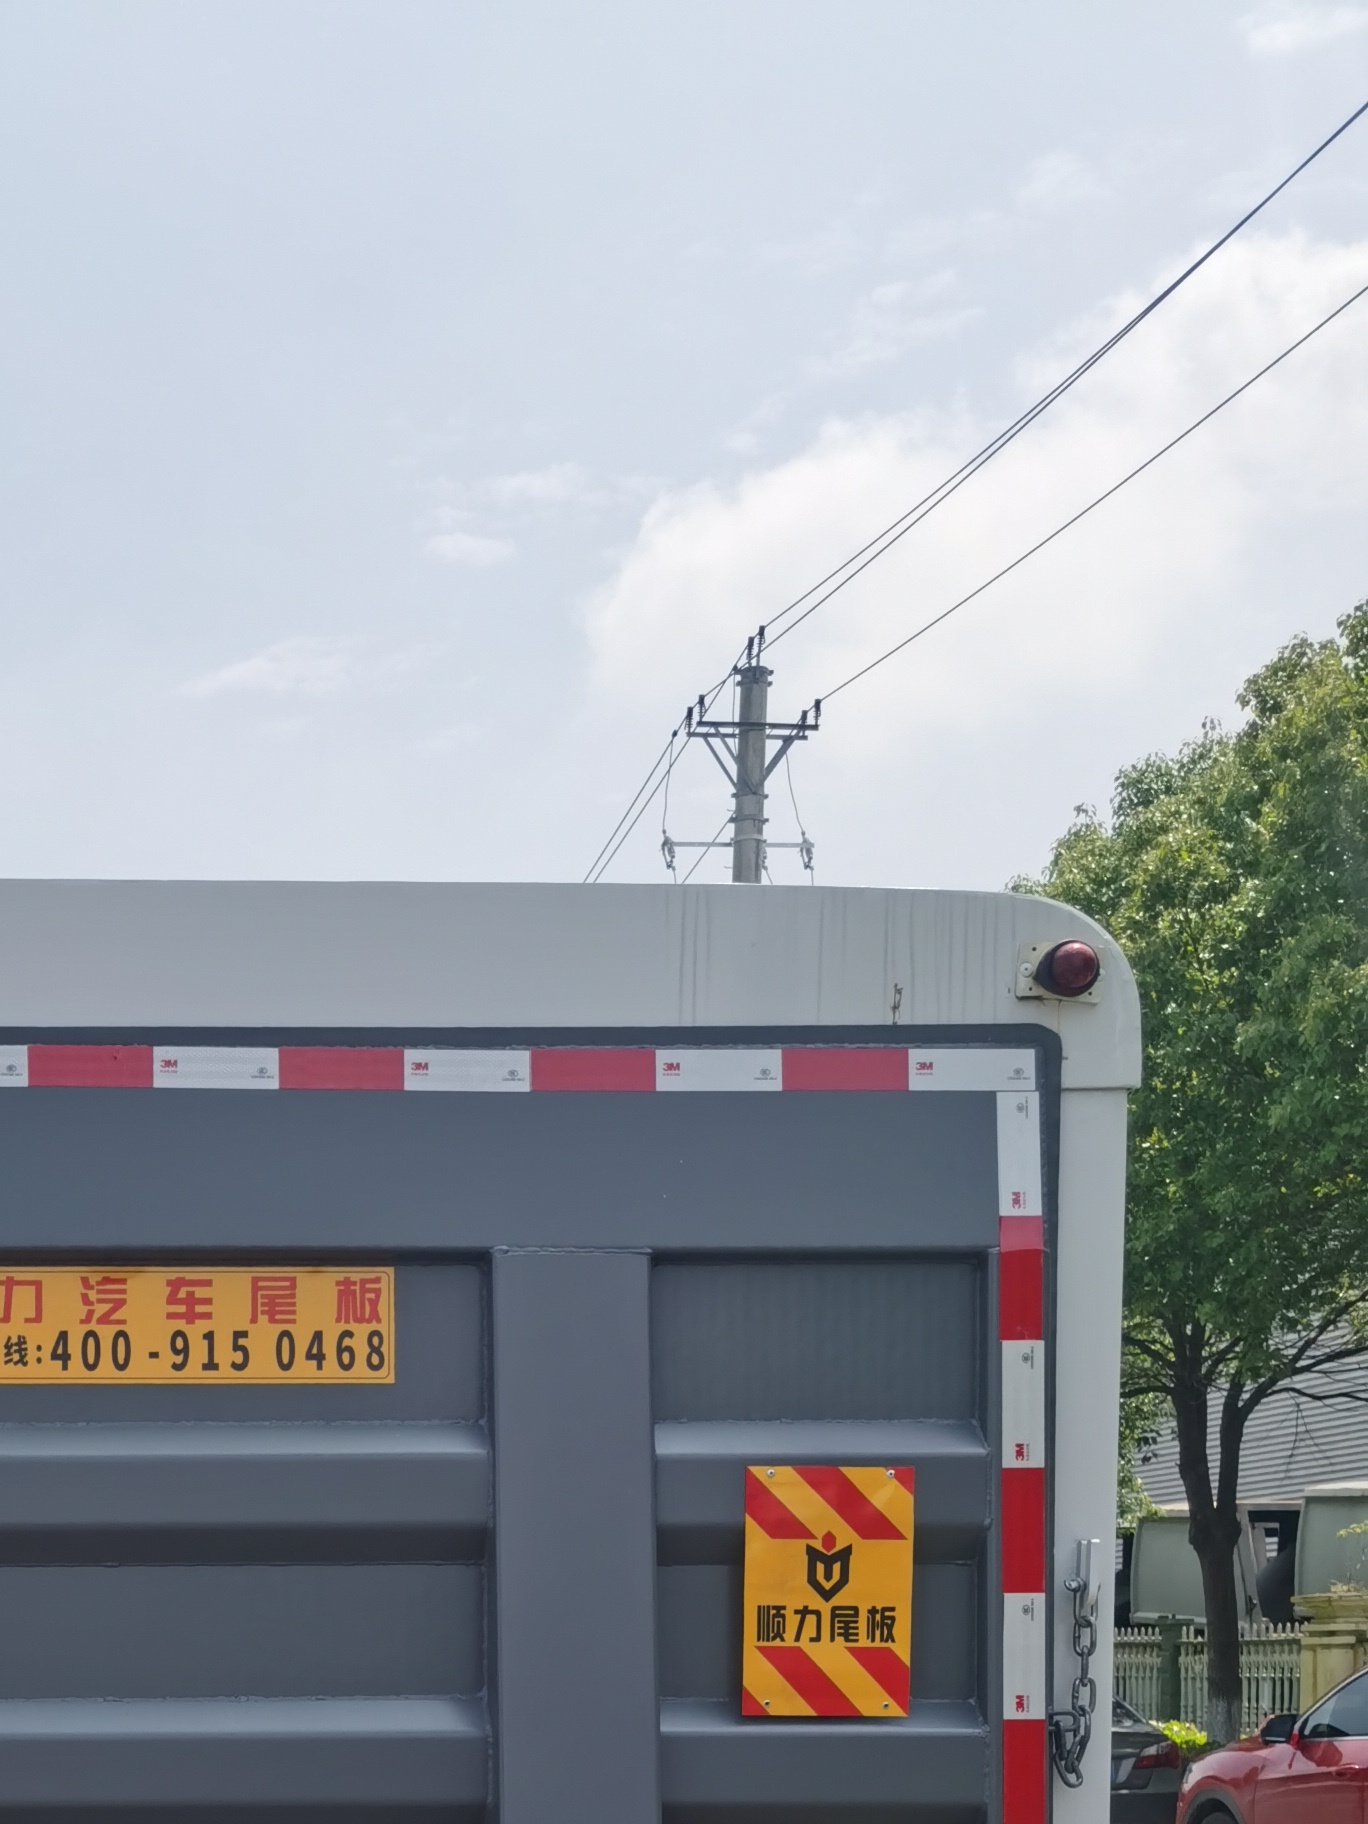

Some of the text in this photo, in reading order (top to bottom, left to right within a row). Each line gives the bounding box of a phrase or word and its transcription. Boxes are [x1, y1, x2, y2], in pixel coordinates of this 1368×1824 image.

[160, 1059, 177, 1068] 3M
[411, 1062, 428, 1071] 3M
[663, 1062, 680, 1071] 3M
[916, 1062, 933, 1071] 3M
[1012, 1193, 1021, 1209] 3M
[1015, 1444, 1026, 1461] 3M
[756, 1604, 896, 1643] 顺力尾板
[1015, 1695, 1025, 1712] 3M
